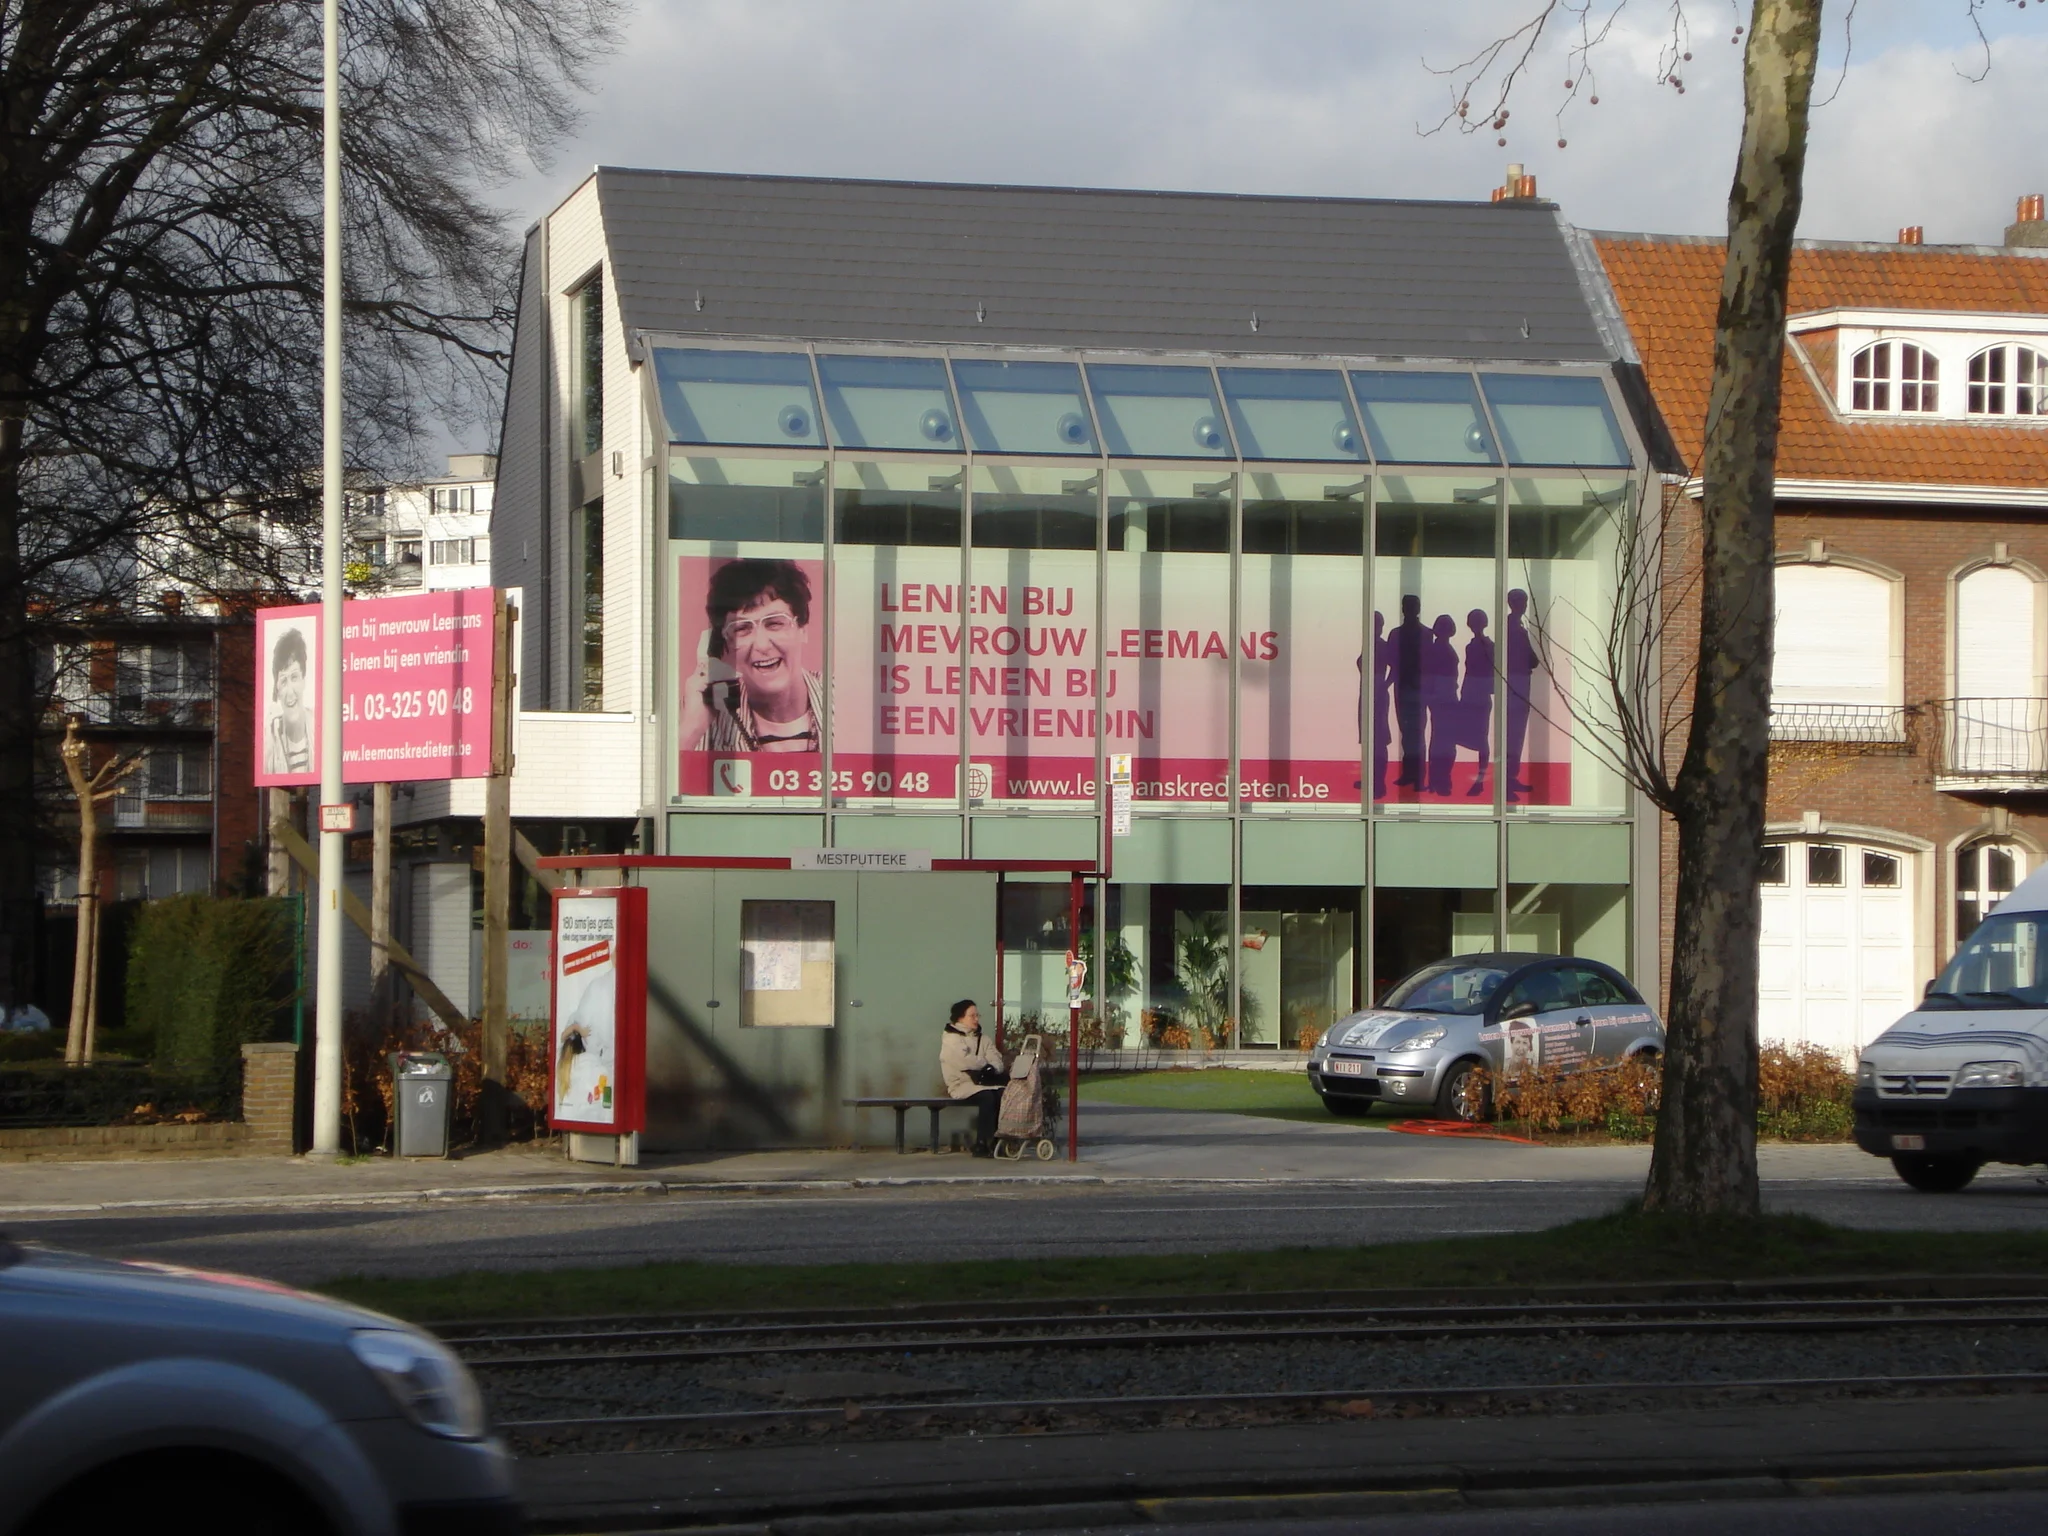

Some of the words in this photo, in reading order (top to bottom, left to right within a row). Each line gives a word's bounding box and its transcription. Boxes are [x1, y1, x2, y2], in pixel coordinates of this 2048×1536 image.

[881, 583, 1007, 614] LENEN
[1022, 587, 1074, 617] BIJ
[362, 618, 376, 641] bij
[379, 618, 431, 636] mevrouw
[433, 613, 482, 632] Leemans
[881, 624, 1087, 656] MEVROUW
[350, 652, 380, 671] lenen
[383, 649, 398, 672] bij
[400, 652, 421, 667] een
[423, 643, 469, 665] vriendin
[880, 665, 911, 694] IS
[925, 666, 1051, 697] LENEN
[1066, 669, 1117, 698] BIJ
[364, 691, 422, 720] 03-325
[427, 688, 448, 716] 90
[452, 686, 473, 714] 48
[880, 705, 956, 735] EEN
[969, 707, 1154, 739] VRIENDIN
[343, 739, 472, 763] ww.leemanskredieten.be
[769, 769, 800, 791] 03
[861, 771, 892, 792] 90
[899, 772, 929, 792] 48
[1008, 772, 1329, 799] www.leanskredeten.be
[816, 853, 907, 866] MESTPUTTEKE
